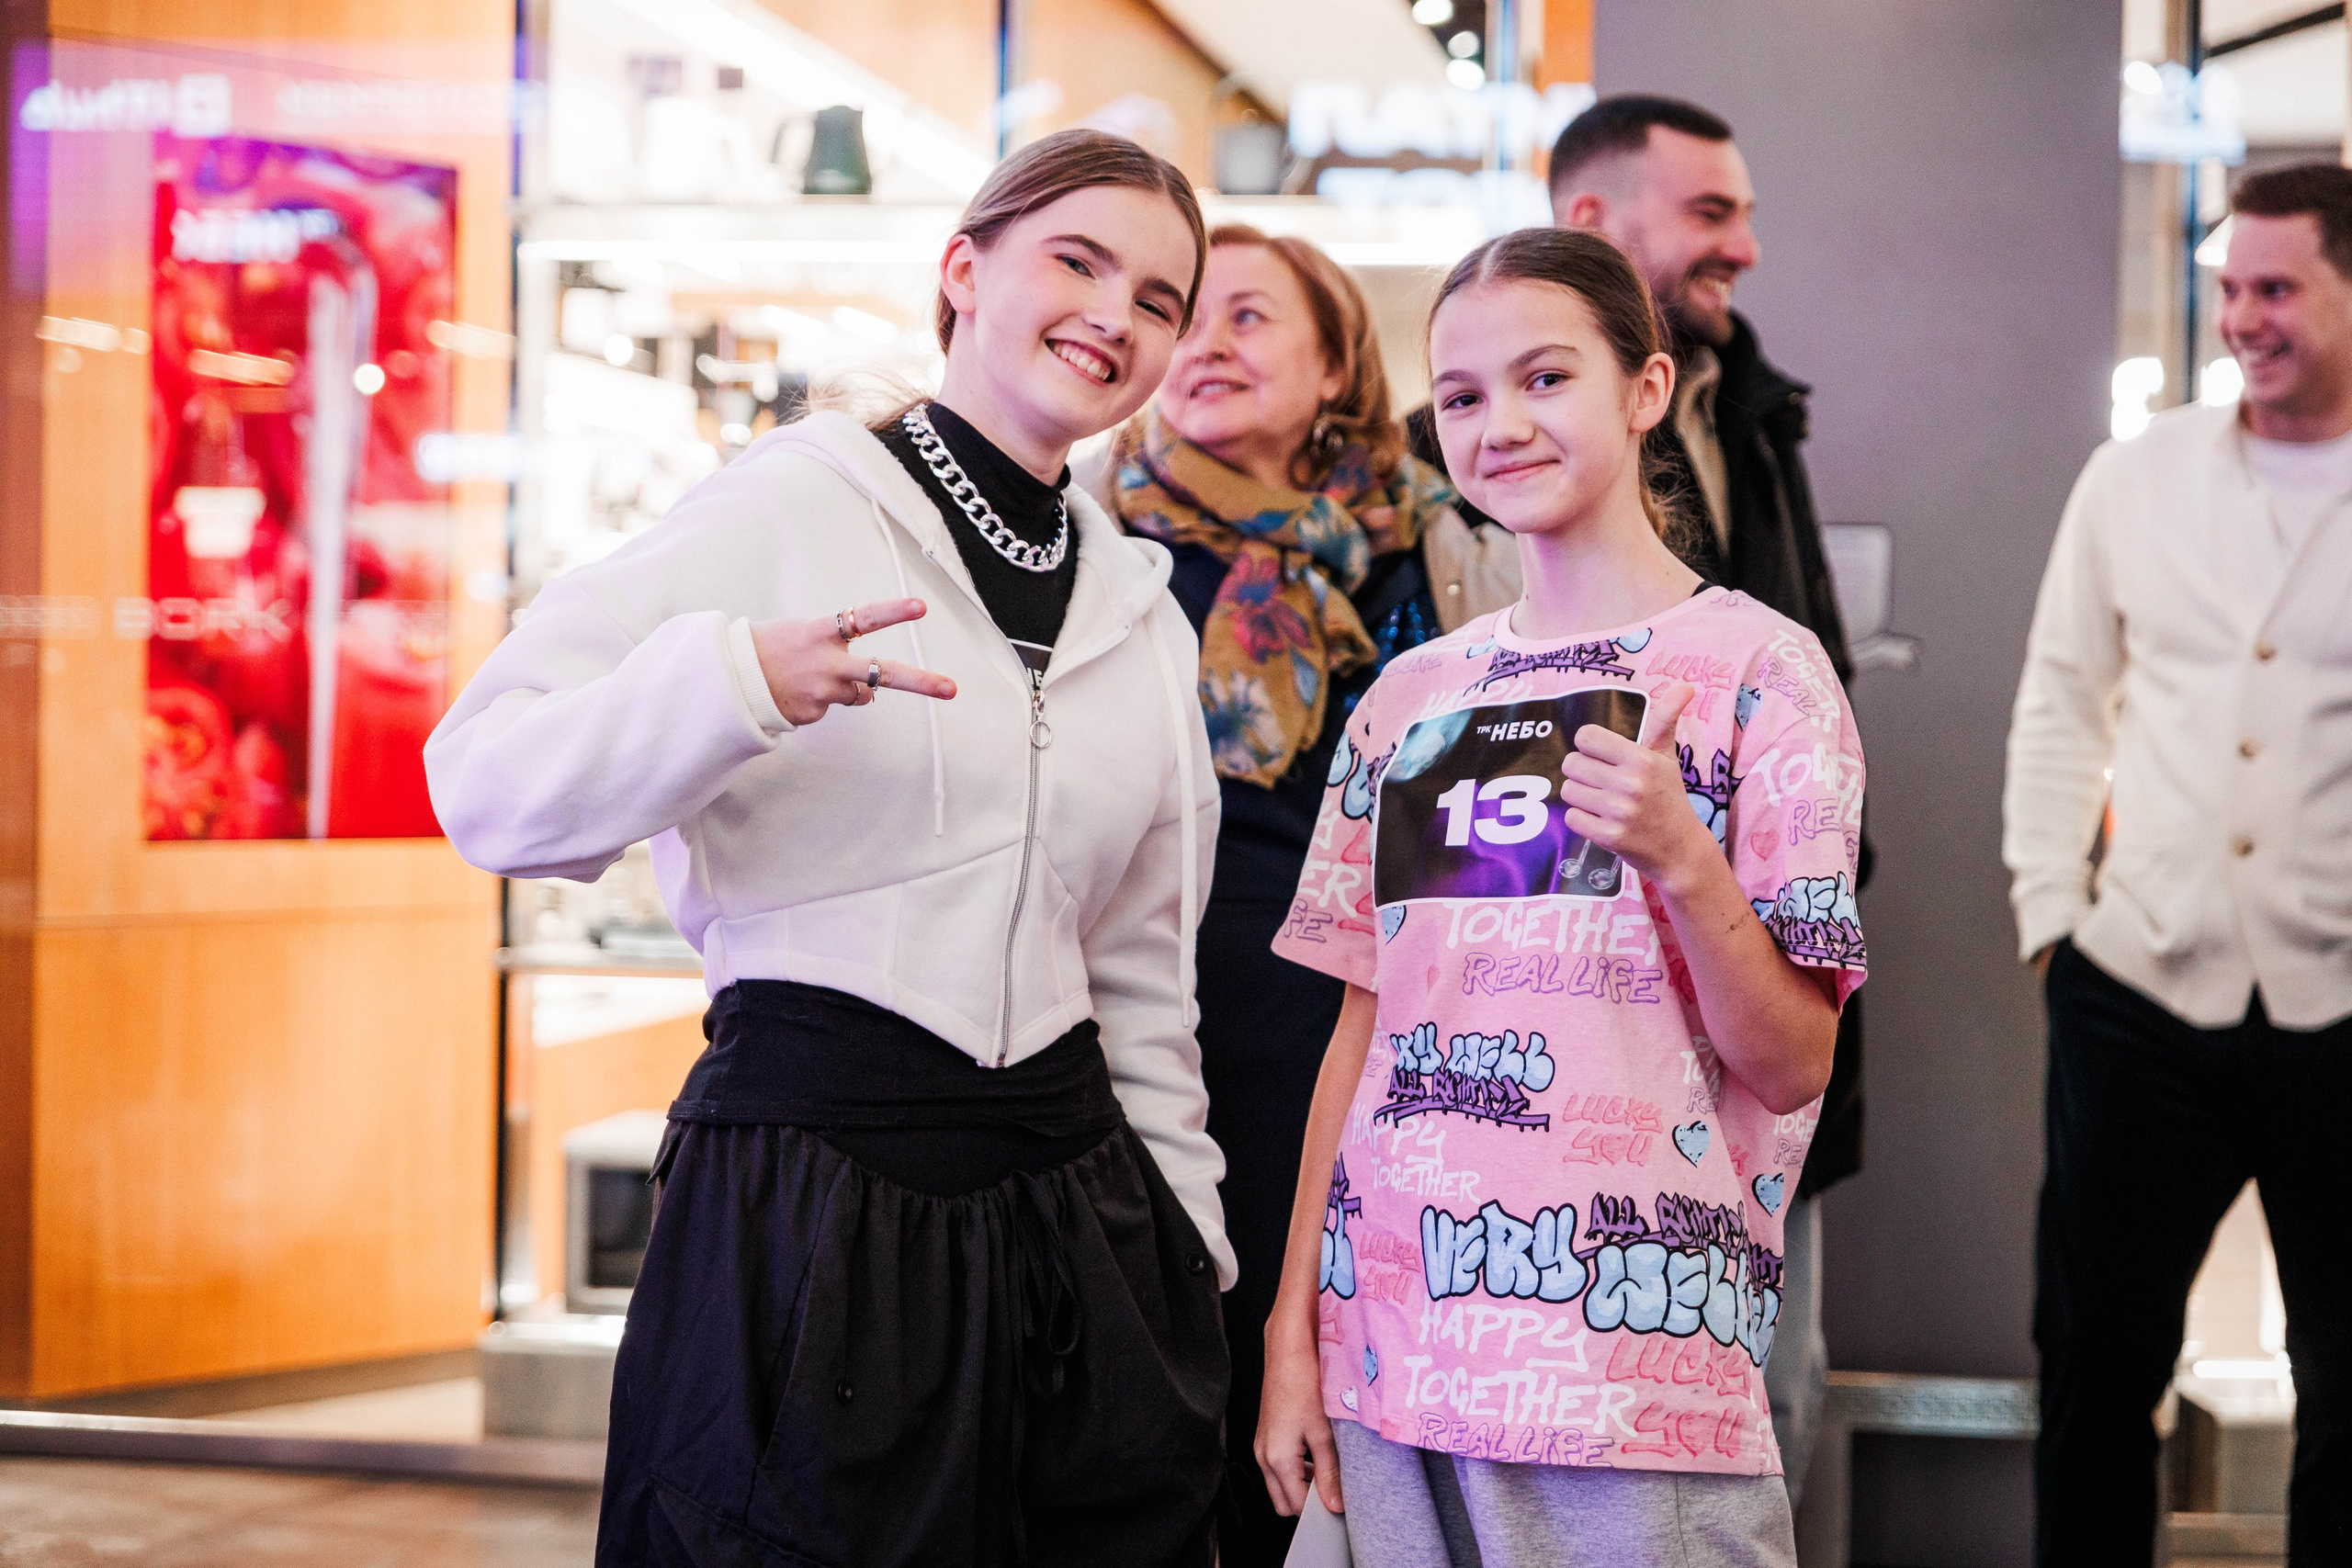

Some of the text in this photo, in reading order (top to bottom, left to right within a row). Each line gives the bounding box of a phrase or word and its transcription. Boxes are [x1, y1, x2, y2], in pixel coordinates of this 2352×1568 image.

[1645, 651, 1737, 691] LUCKY
[1476, 721, 1553, 741] ТРК НЕБО
[1435, 774, 1554, 847] 13
[1463, 952, 1565, 997] REAL
[1562, 1092, 1664, 1134] LUCKY
[1371, 1156, 1481, 1204] TOGETHER
[1420, 1199, 1590, 1303] VERY
[1419, 1298, 1589, 1372] HAPPY
[1606, 1333, 1751, 1401] LUCKY
[1403, 1355, 1638, 1438] TOGETHER
[1417, 1412, 1512, 1461] REAL
